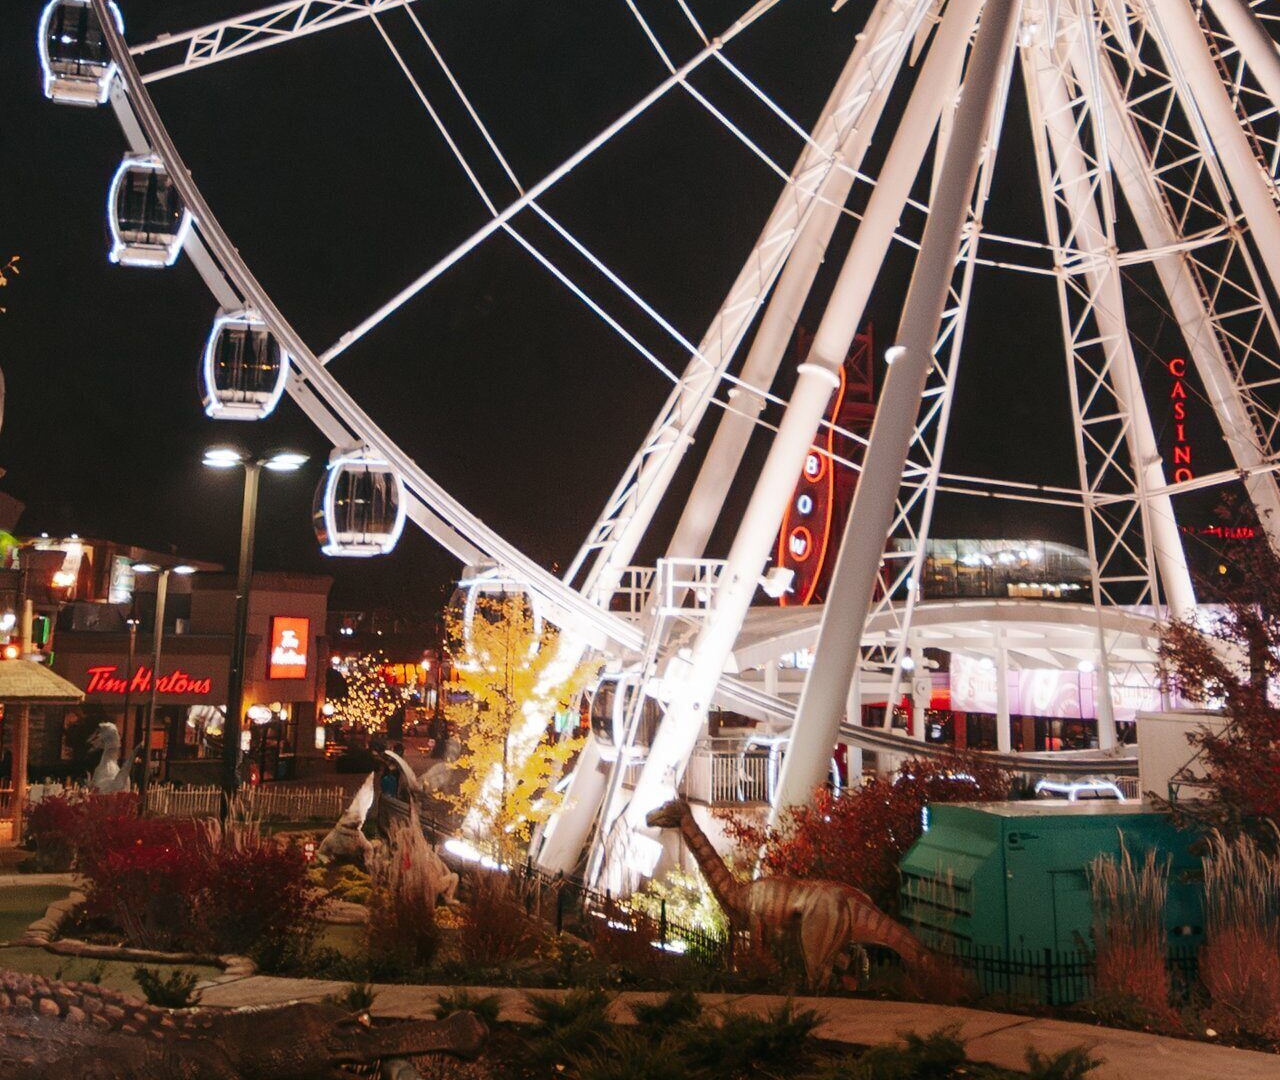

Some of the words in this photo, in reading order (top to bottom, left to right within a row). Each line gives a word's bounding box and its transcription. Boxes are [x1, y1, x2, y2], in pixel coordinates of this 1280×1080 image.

[1168, 357, 1194, 483] CASINO
[87, 666, 127, 693] Tim
[129, 666, 212, 694] Hrtons
